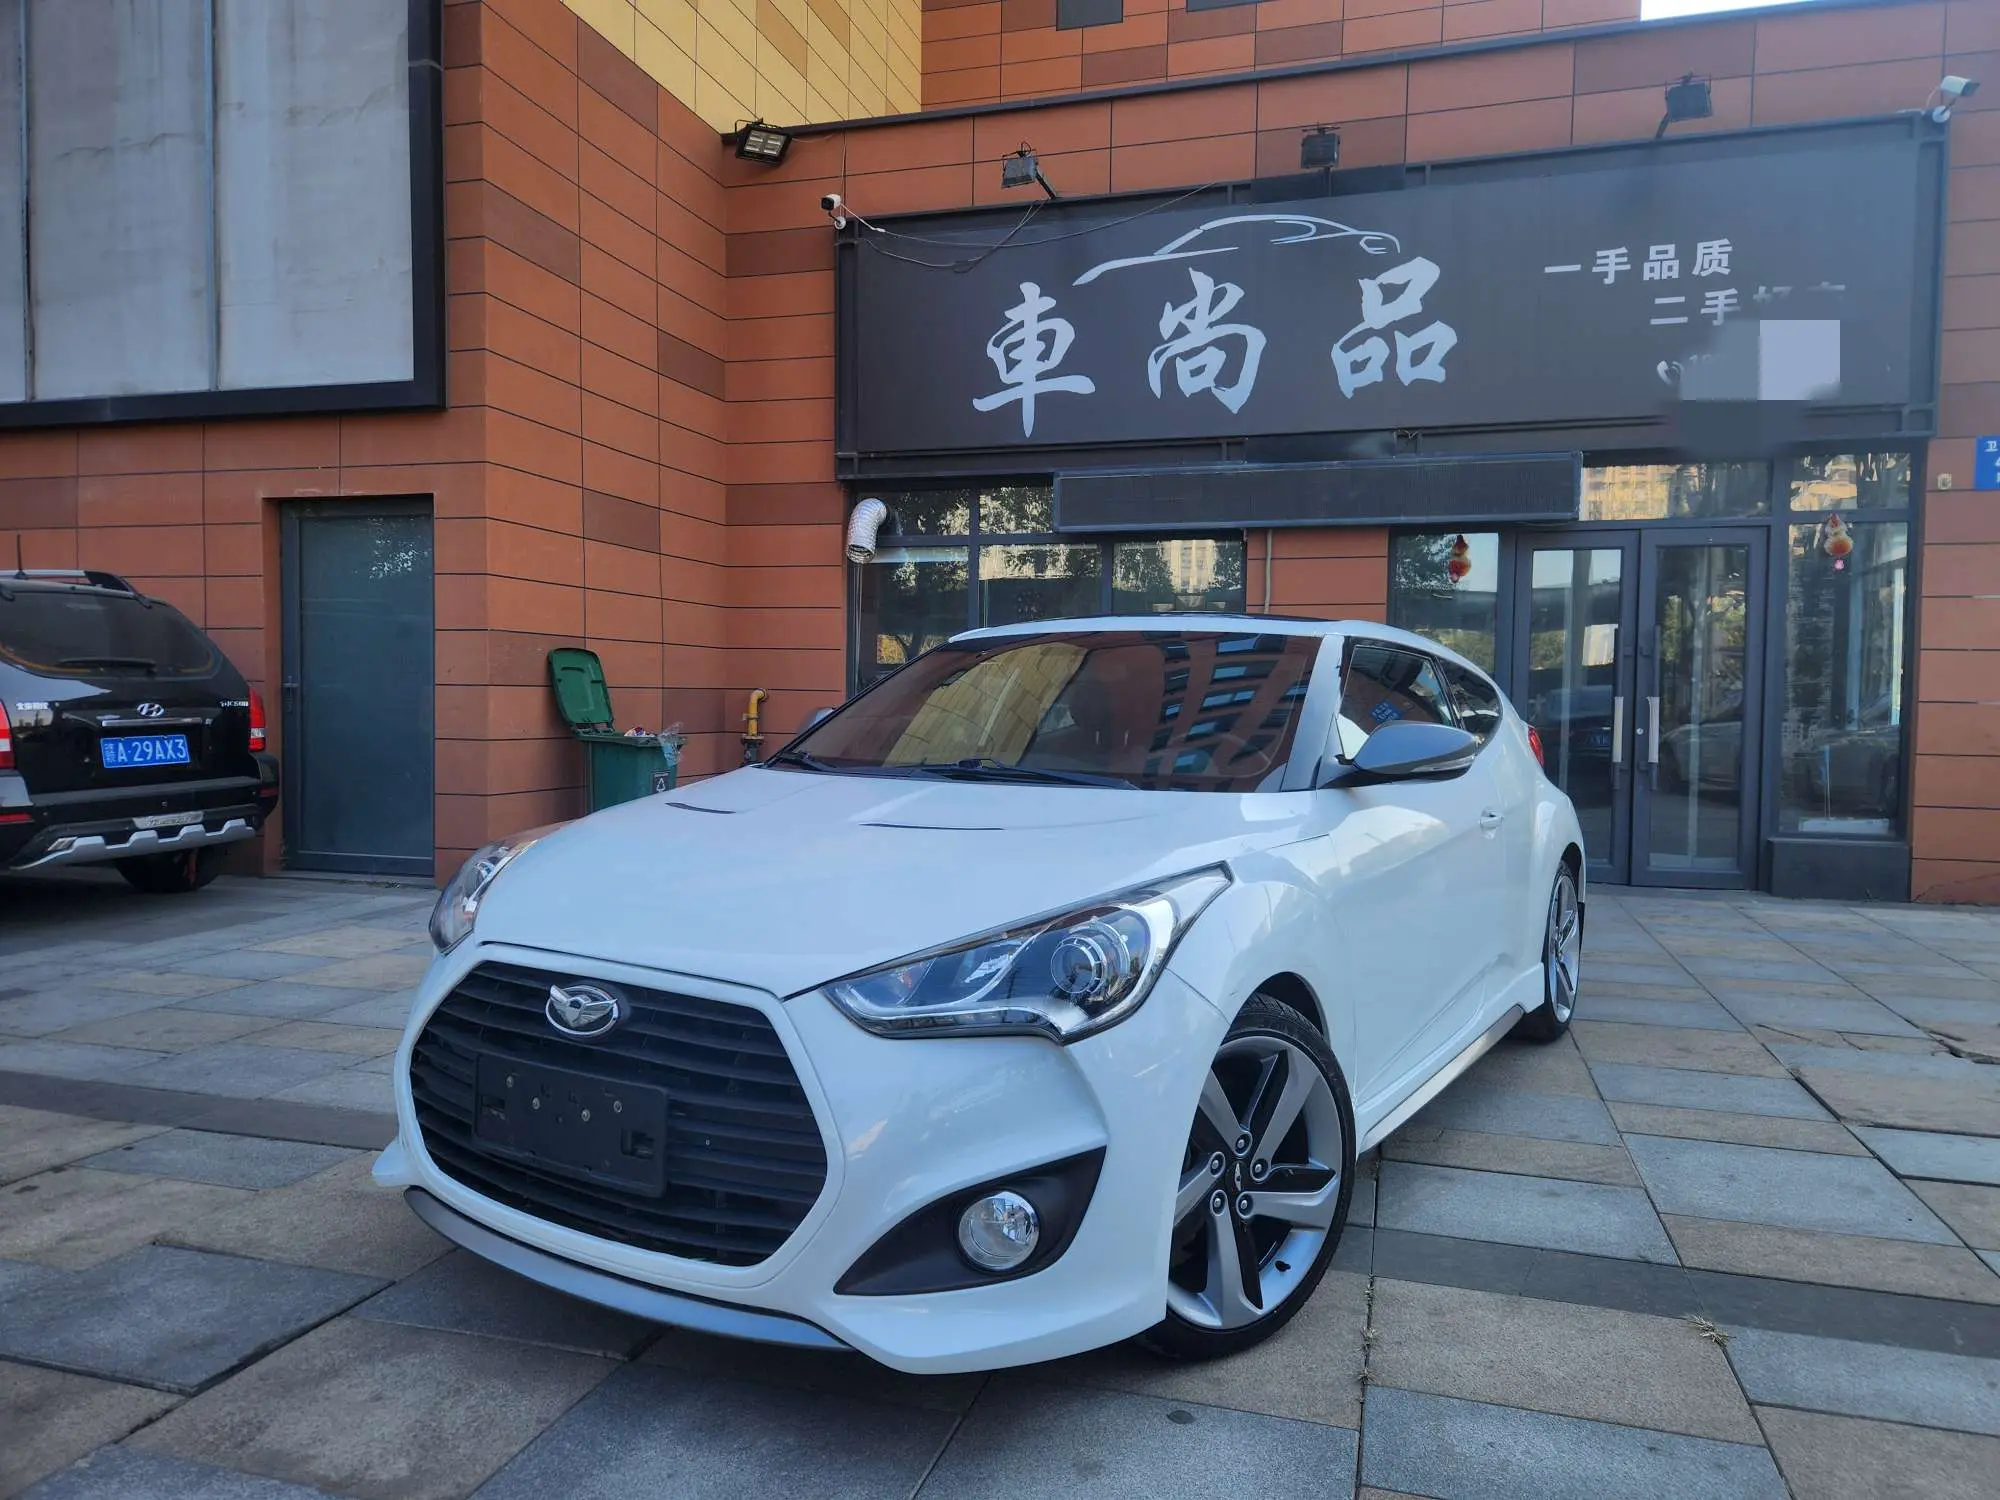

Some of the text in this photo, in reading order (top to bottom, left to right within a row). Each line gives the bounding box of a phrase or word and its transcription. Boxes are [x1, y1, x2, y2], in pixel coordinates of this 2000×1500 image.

[1544, 238, 1733, 285] 一手品质
[972, 256, 1458, 438] 車尚品
